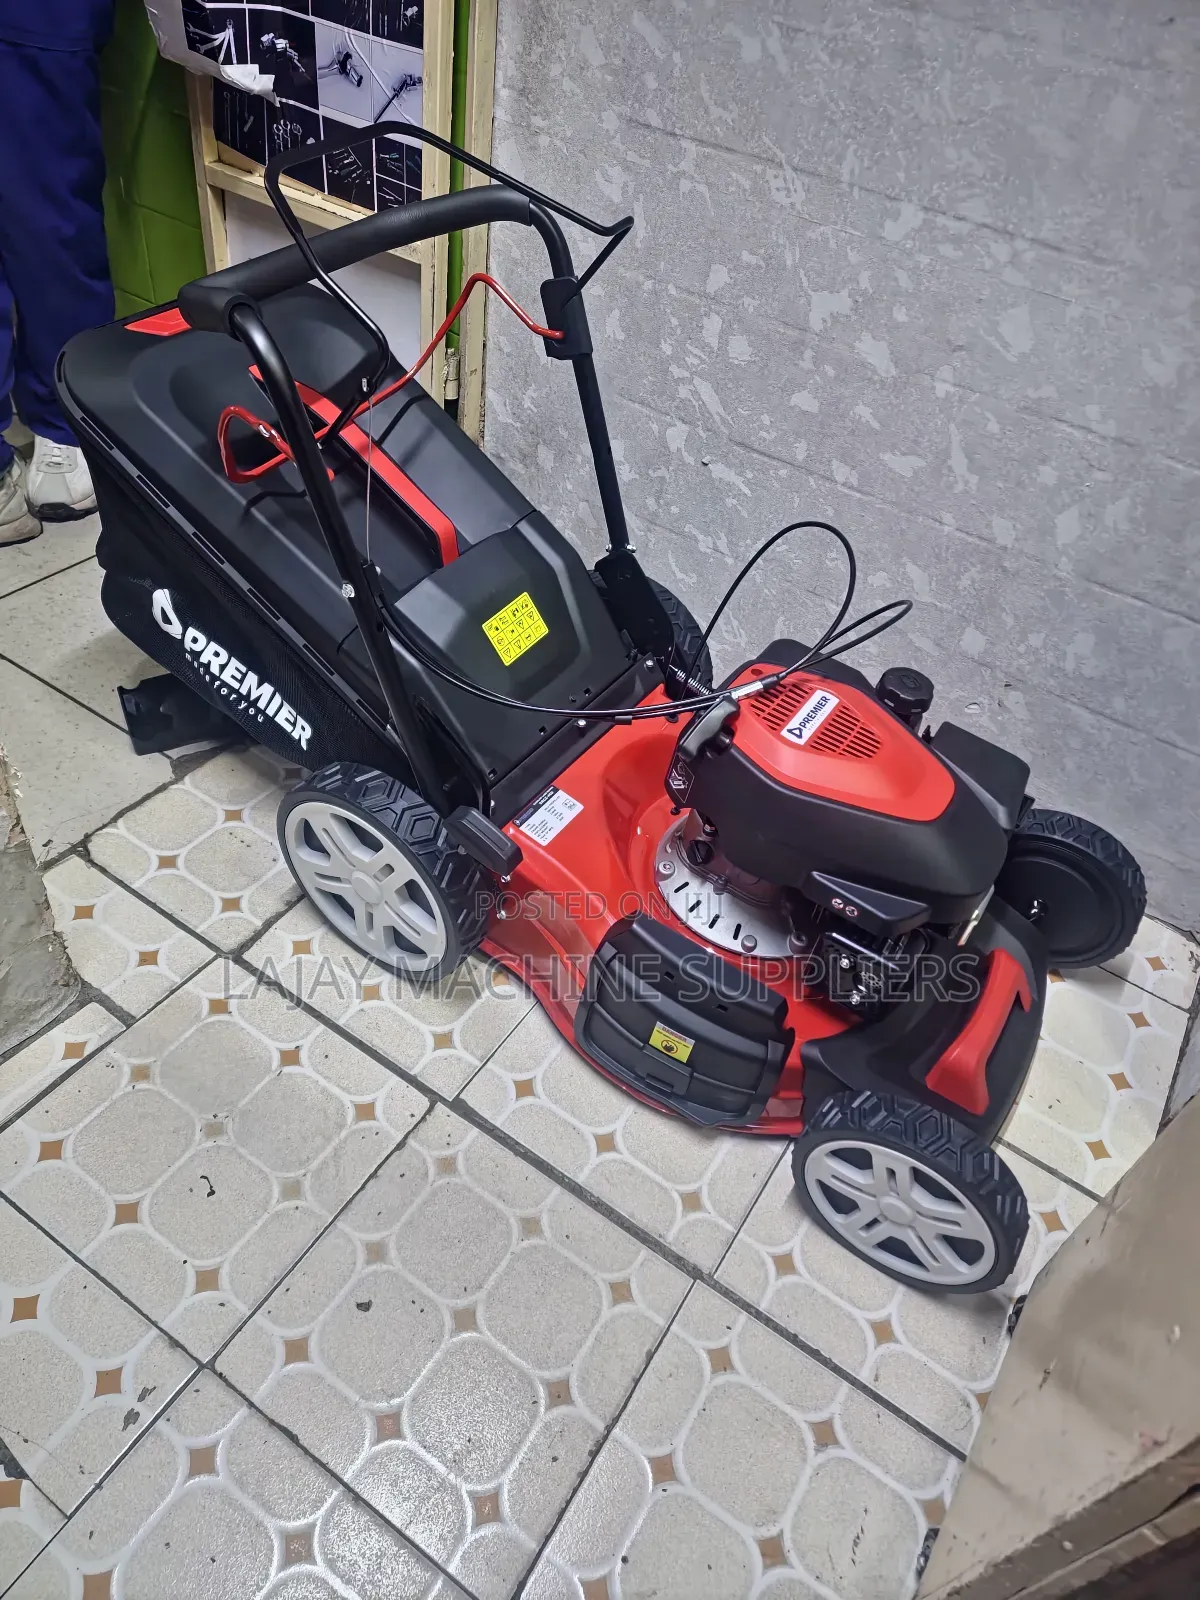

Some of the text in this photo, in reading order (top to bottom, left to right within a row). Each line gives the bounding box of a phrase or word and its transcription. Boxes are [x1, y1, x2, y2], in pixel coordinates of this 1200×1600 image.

[184, 626, 313, 751] PREMIER
[185, 652, 264, 723] made for you
[798, 695, 831, 729] PREMIER
